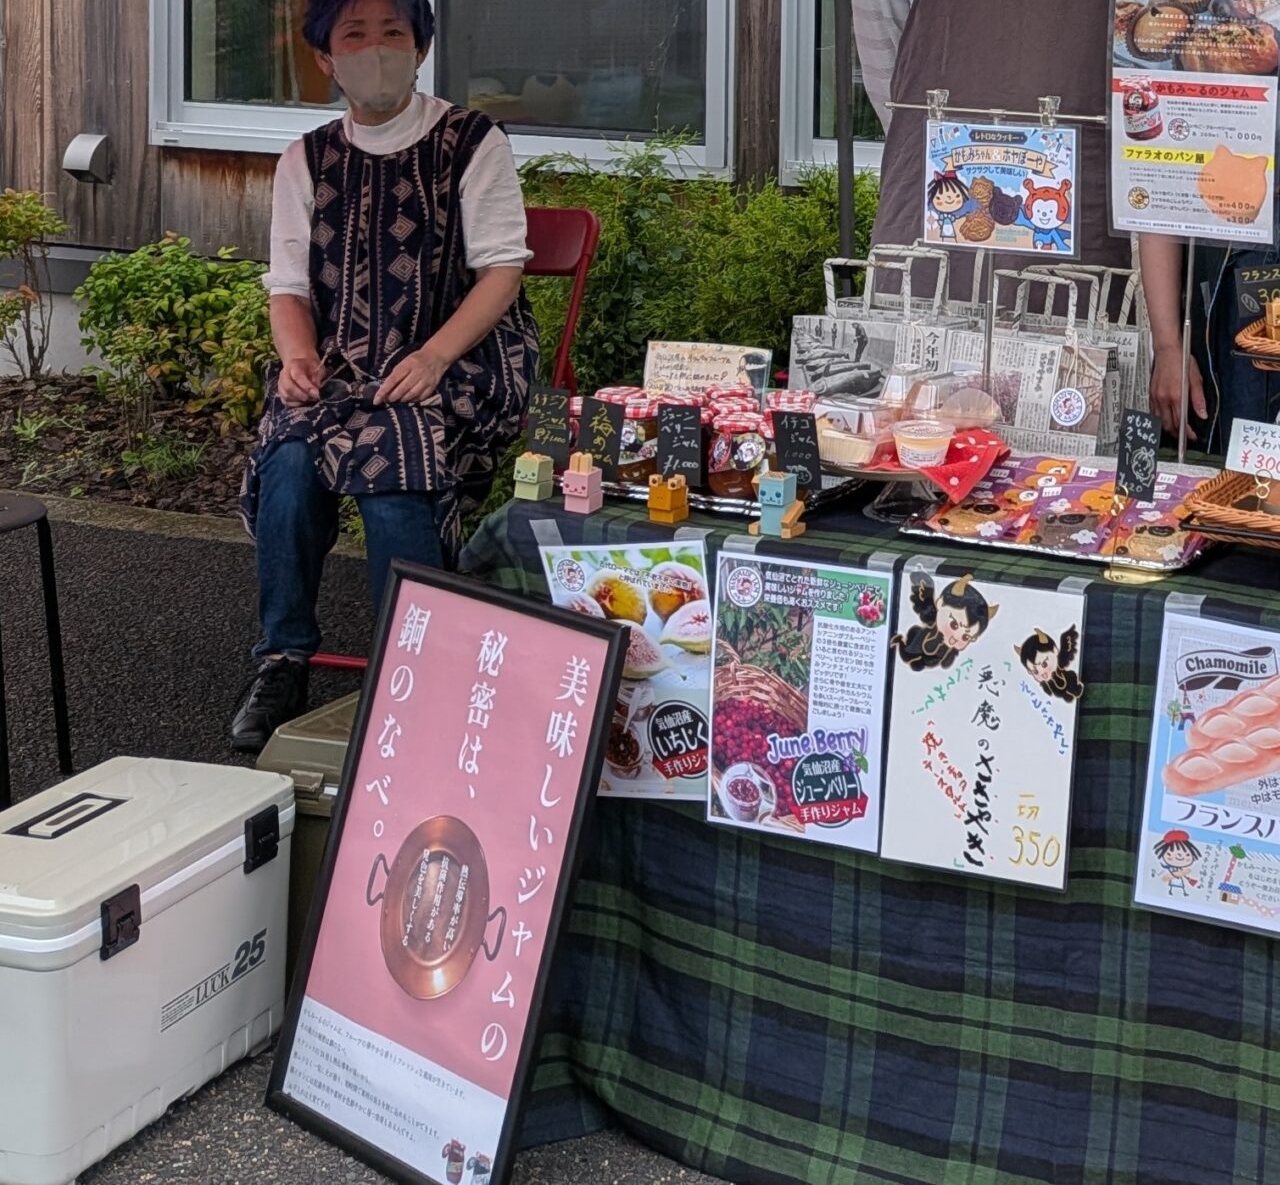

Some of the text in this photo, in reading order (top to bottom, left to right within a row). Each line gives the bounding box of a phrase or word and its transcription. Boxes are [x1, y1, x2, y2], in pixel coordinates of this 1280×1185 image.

[1185, 656, 1268, 675] Chamomile
[366, 602, 432, 838] 銅のなべ。
[655, 710, 694, 731] 気仙沼産
[655, 721, 709, 759] いちじく
[768, 726, 868, 763] June Berry
[802, 759, 842, 777] 気仙沼産
[795, 775, 858, 803] ジューンベリー
[799, 802, 862, 822] 手作りジャム
[482, 655, 590, 1062] 美味しいジャムの
[1009, 825, 1061, 868] 350
[195, 928, 267, 1005] LUCK 25
